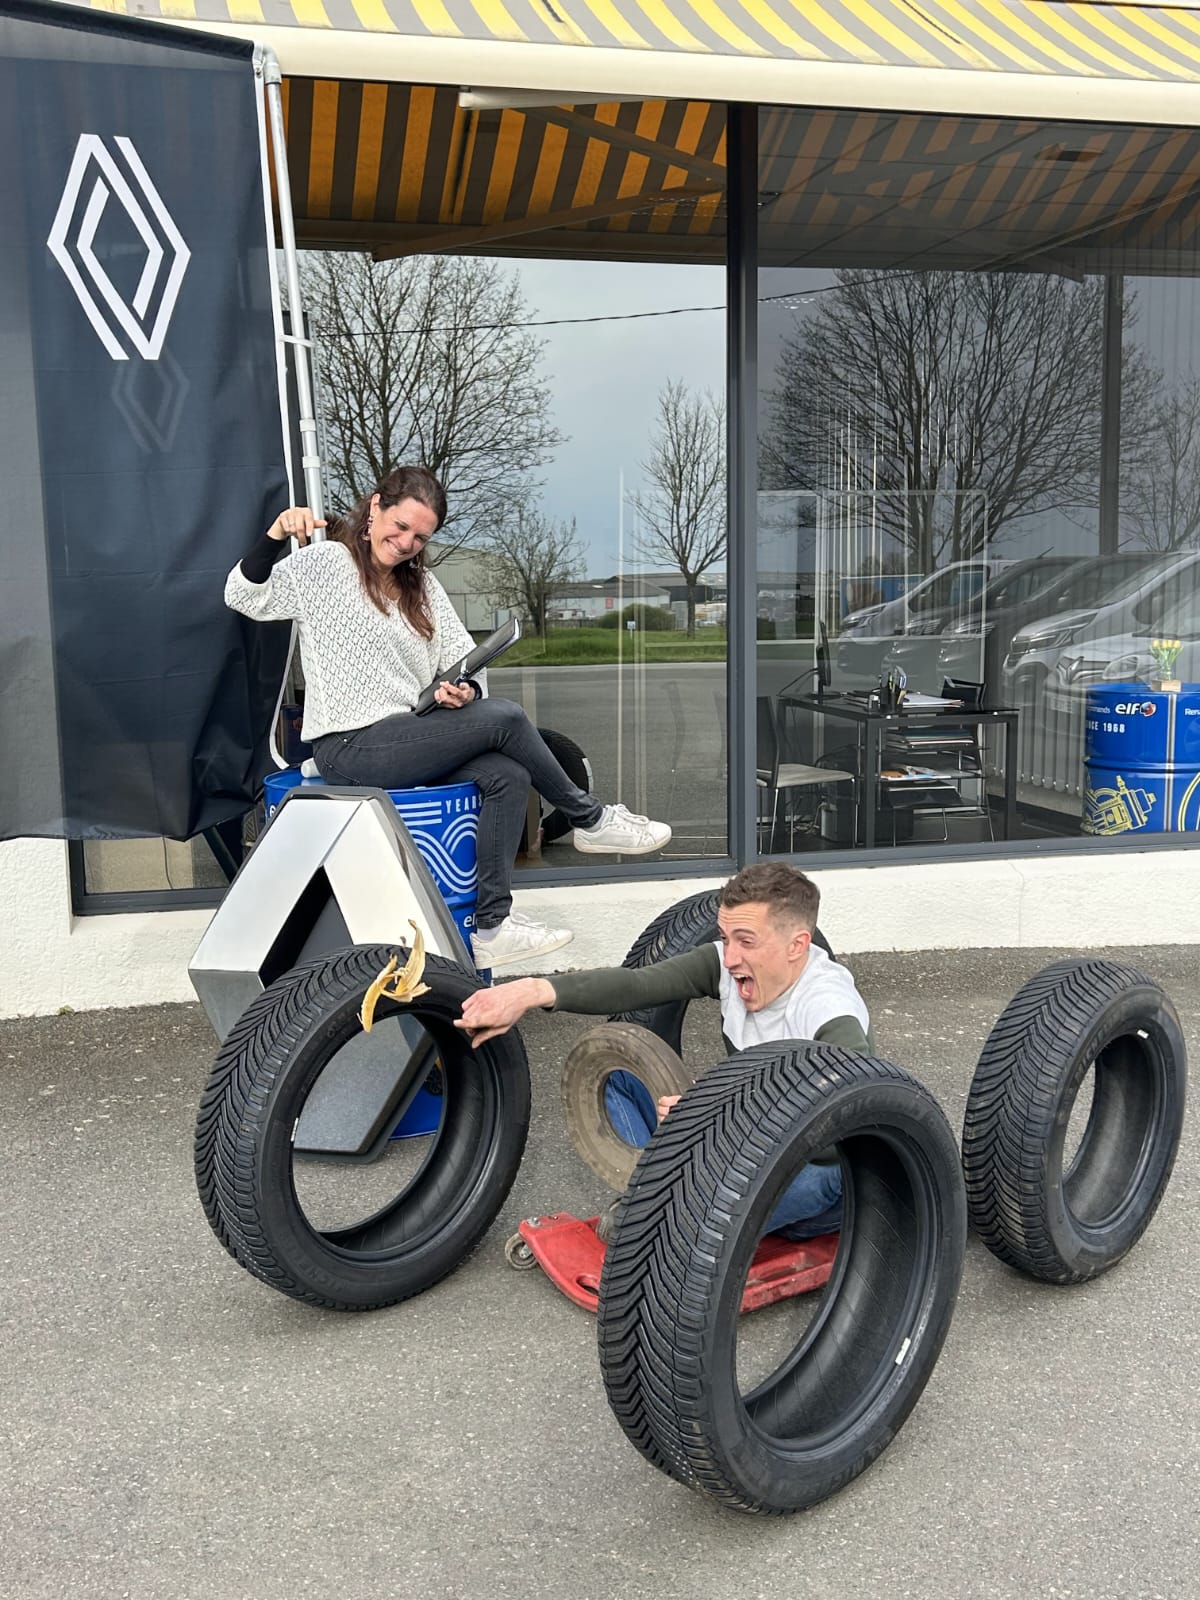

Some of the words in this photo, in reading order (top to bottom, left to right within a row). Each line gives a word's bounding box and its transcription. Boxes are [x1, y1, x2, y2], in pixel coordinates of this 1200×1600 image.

[1115, 703, 1140, 715] elf
[1103, 722, 1126, 734] 1968
[463, 912, 477, 928] el
